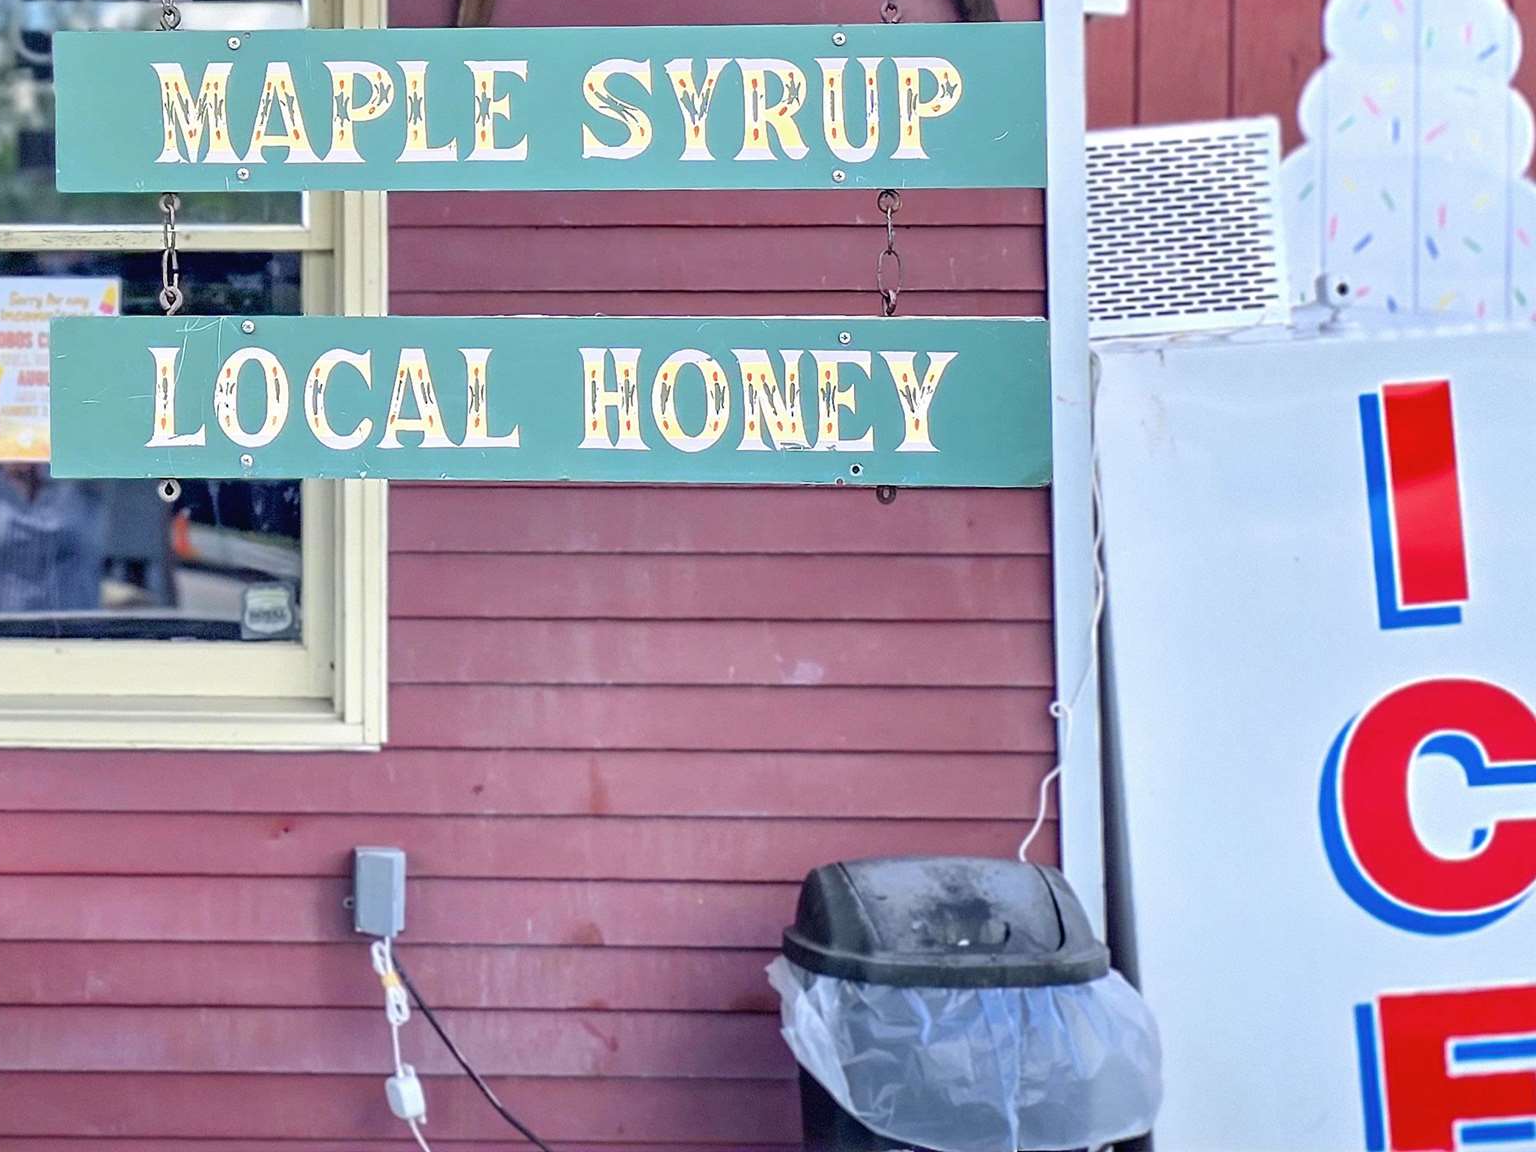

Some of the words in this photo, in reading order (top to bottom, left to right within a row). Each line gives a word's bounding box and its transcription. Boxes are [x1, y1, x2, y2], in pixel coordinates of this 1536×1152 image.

[150, 58, 529, 165] MAPLE
[580, 55, 964, 162] SYRUP
[145, 345, 521, 452] LOCAL
[578, 347, 960, 453] HONEY
